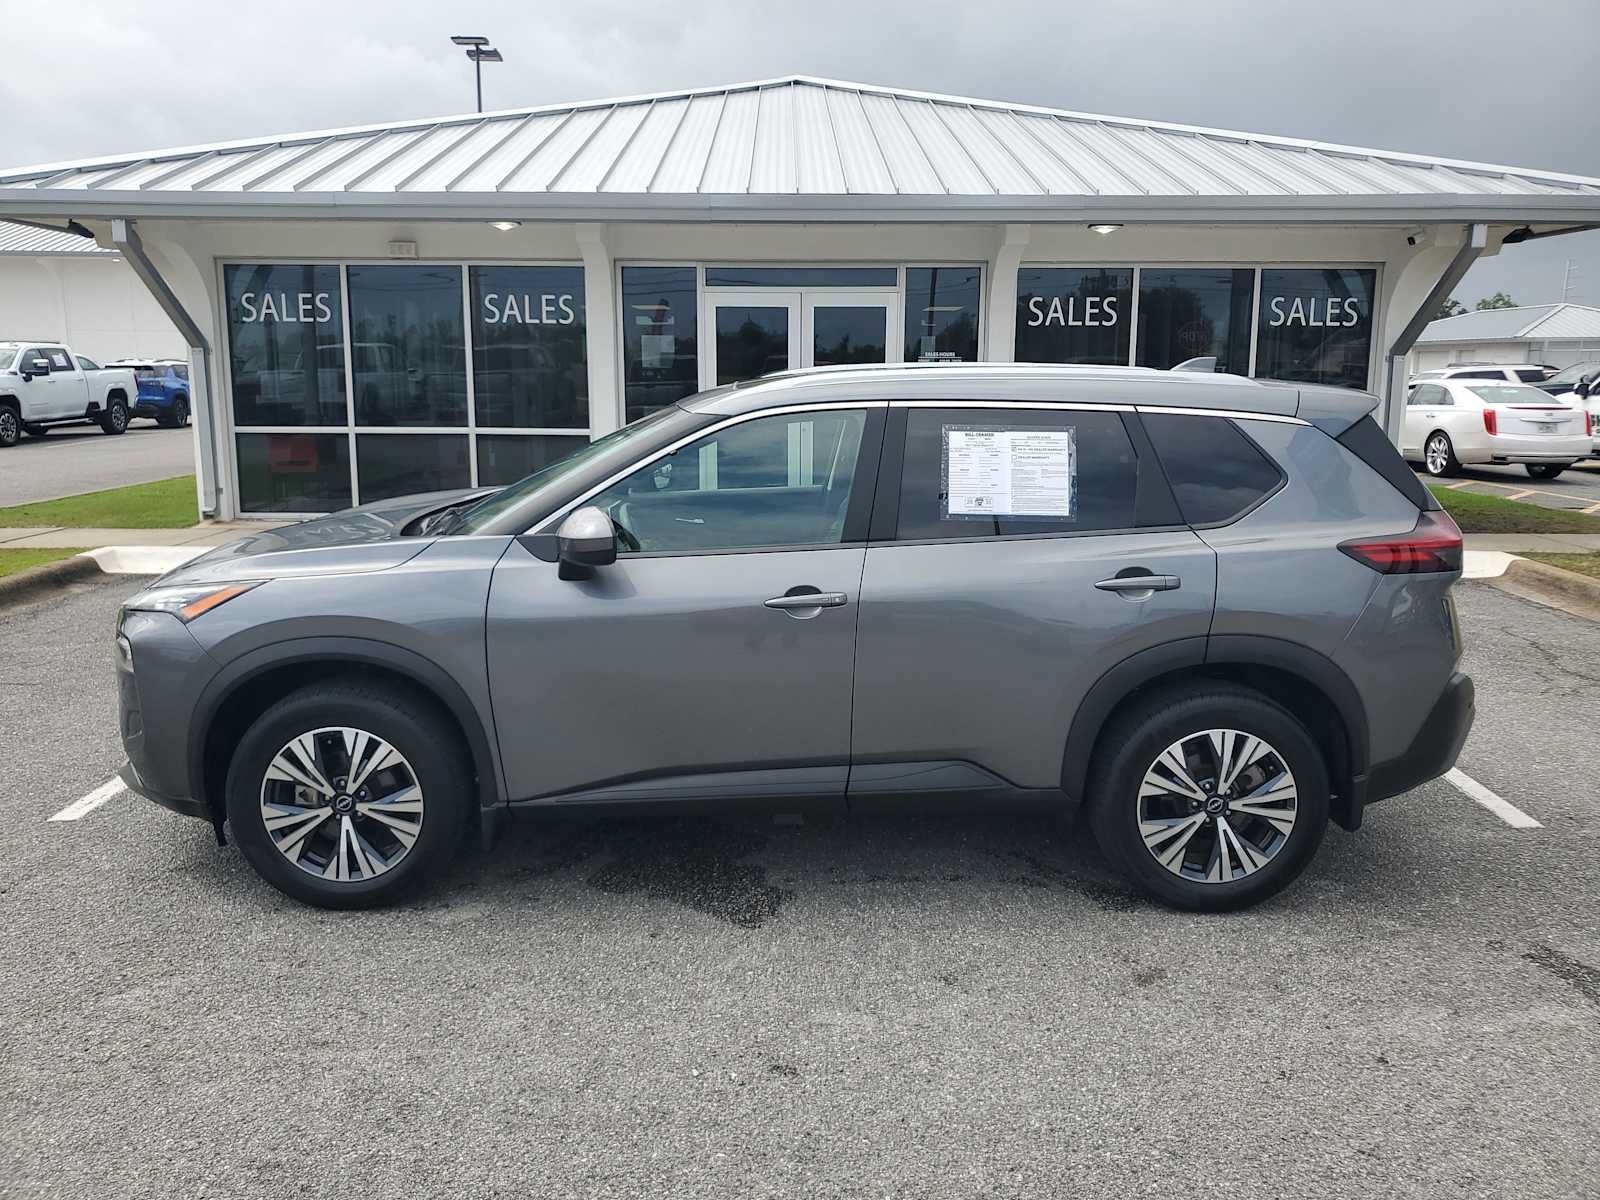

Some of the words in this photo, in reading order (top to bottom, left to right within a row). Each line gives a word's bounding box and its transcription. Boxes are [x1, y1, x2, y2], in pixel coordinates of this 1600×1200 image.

[241, 293, 331, 322] SALES
[484, 294, 575, 324] SALES
[1028, 296, 1118, 326] SALES
[1269, 296, 1359, 327] SALES
